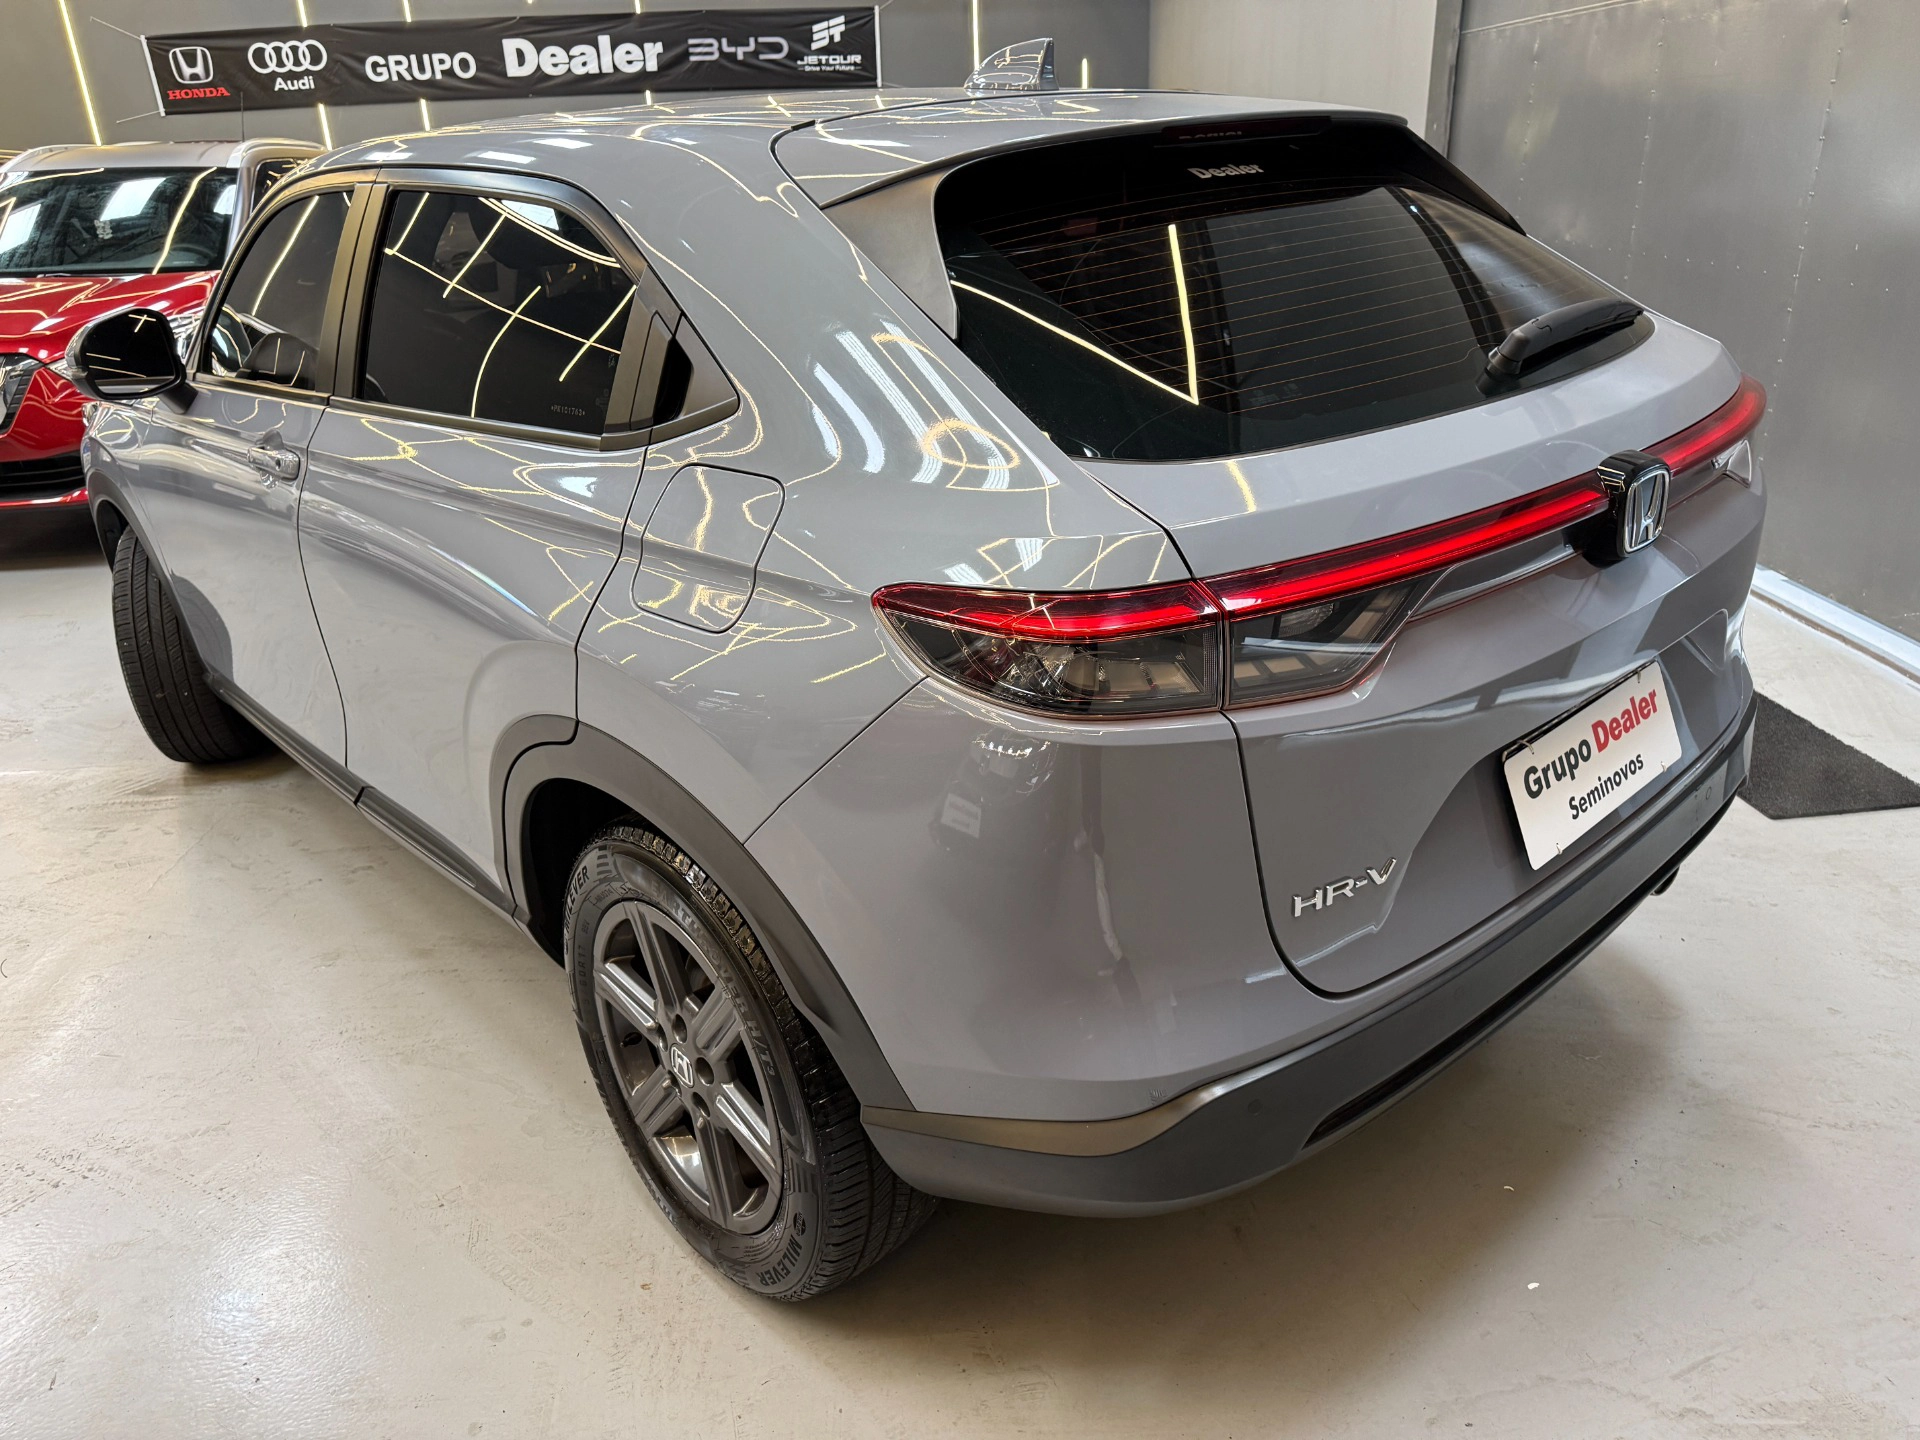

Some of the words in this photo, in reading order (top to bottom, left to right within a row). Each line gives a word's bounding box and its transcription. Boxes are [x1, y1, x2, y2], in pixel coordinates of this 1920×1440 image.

[364, 51, 478, 83] GRUPO
[501, 34, 664, 78] Dealer
[687, 35, 789, 62] BYD
[796, 54, 862, 66] JETOUR
[166, 86, 231, 101] HONDA
[273, 75, 316, 92] Audi
[1187, 164, 1265, 179] Dealer
[1523, 738, 1592, 799] Grupo
[1591, 688, 1659, 754] Dealer
[1568, 753, 1644, 821] Seminovos
[1292, 856, 1397, 918] HR-V
[755, 1232, 803, 1287] MILEVER
